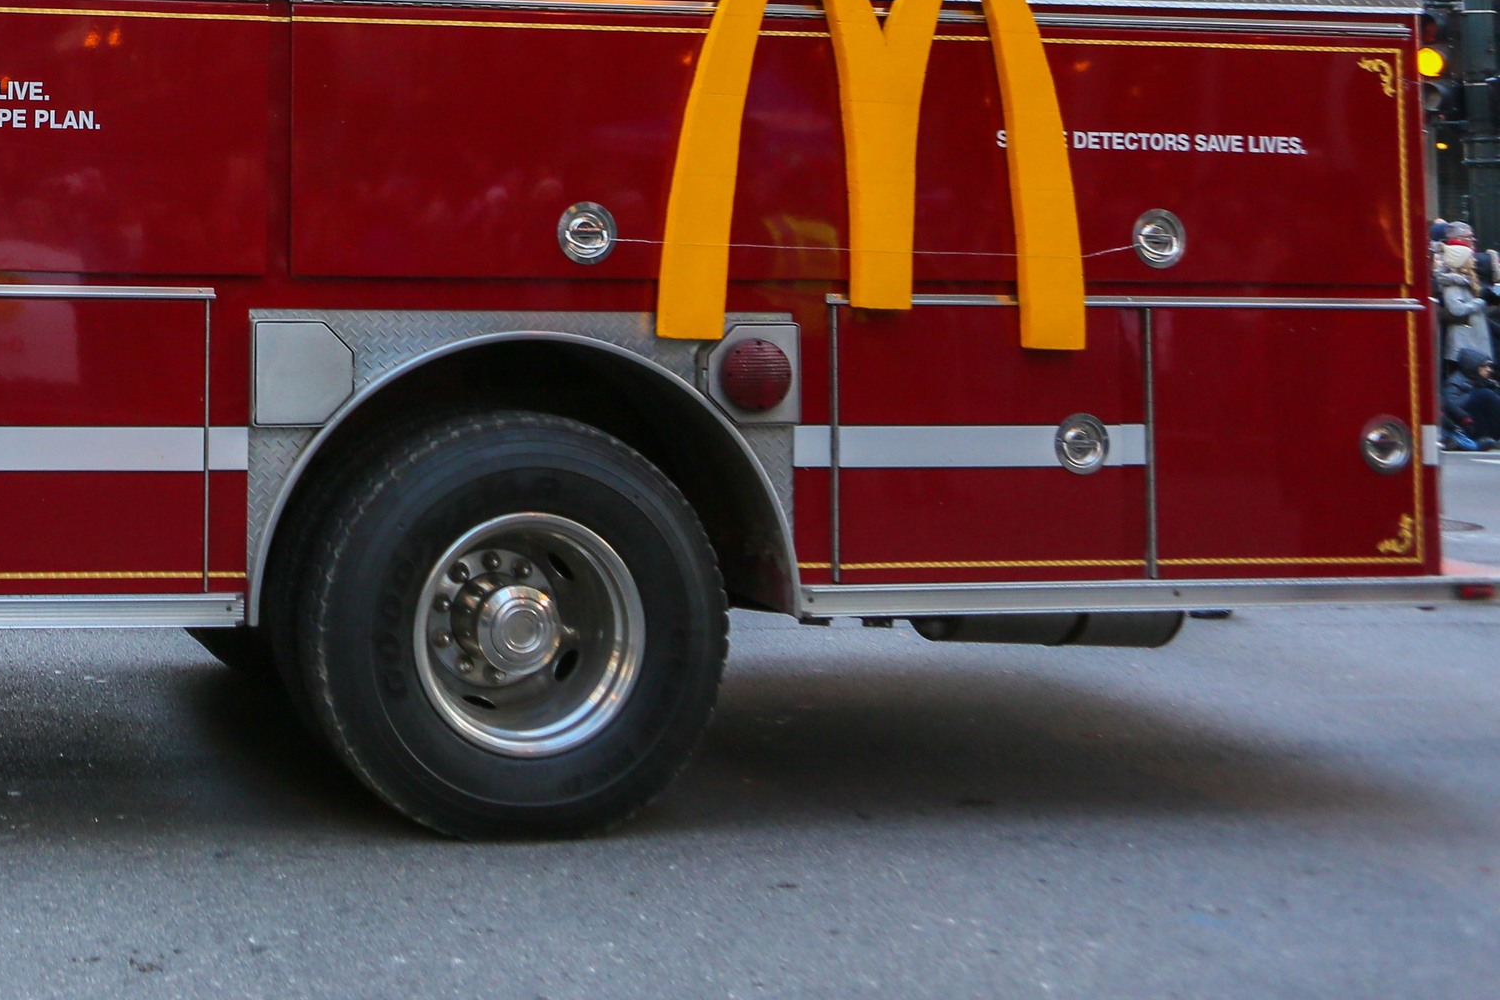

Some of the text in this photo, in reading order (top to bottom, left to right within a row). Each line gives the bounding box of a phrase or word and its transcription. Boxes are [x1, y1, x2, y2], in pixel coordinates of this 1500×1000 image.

[34, 109, 101, 130] PLAN.
[1073, 130, 1191, 151] DETECTORS
[1194, 133, 1244, 153] SAVE
[1249, 135, 1308, 155] LIVES.
